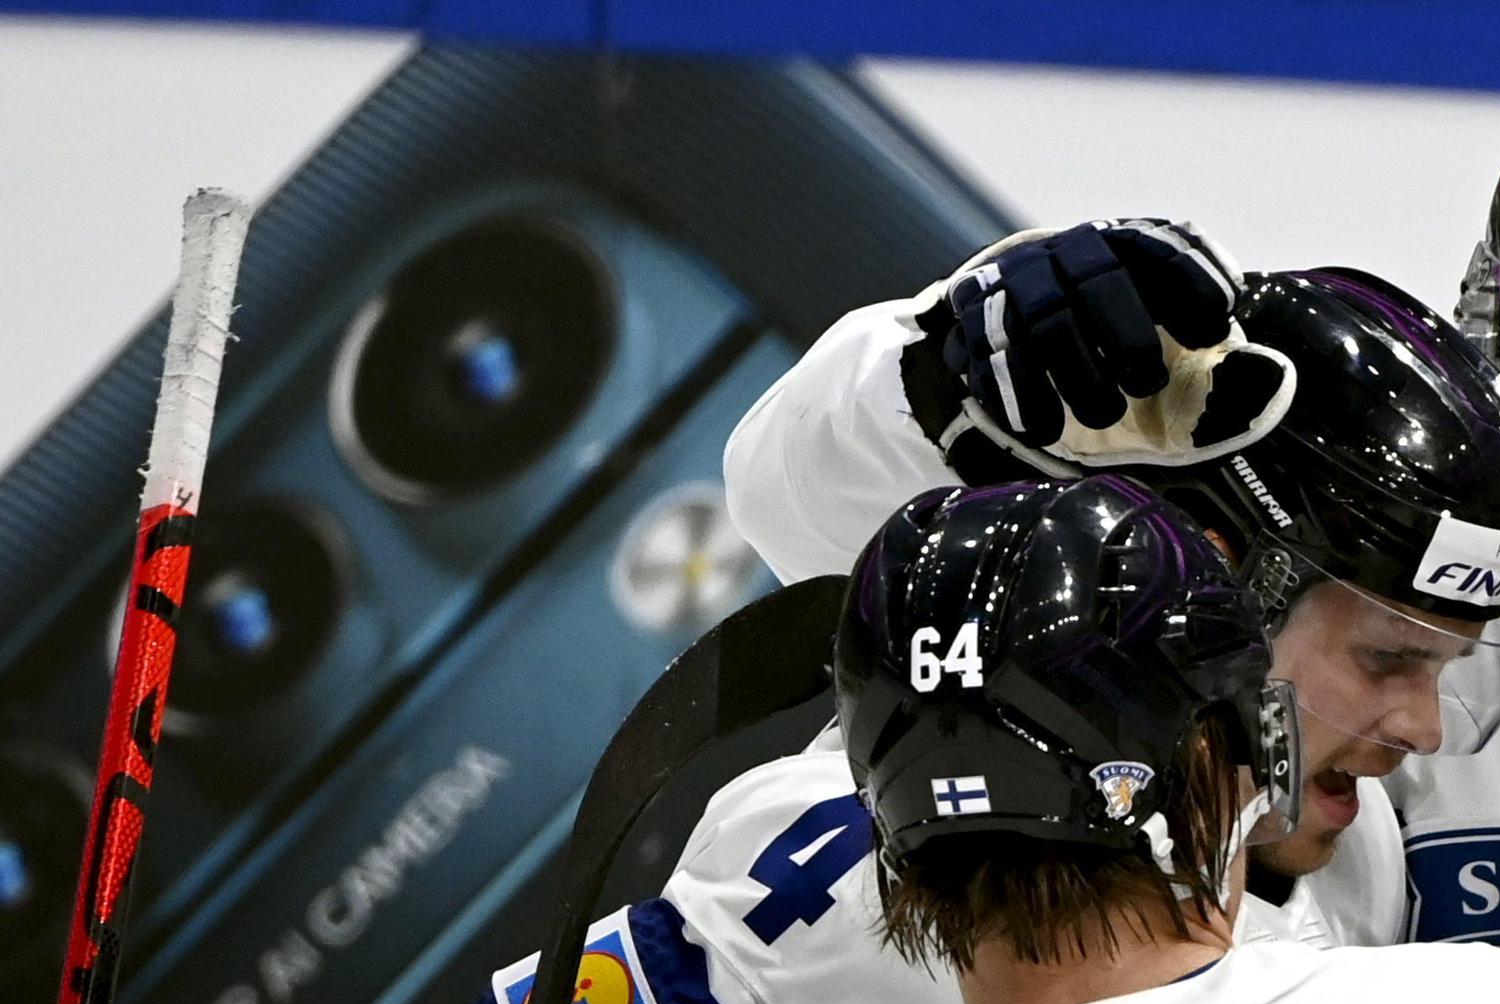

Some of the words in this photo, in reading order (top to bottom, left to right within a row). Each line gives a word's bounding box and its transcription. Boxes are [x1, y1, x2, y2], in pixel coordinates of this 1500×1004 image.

[1230, 454, 1294, 528] ARRIOR
[909, 622, 983, 693] 64
[1101, 766, 1145, 779] SUOMI
[306, 745, 511, 947] CAMERA
[741, 792, 876, 947] 4
